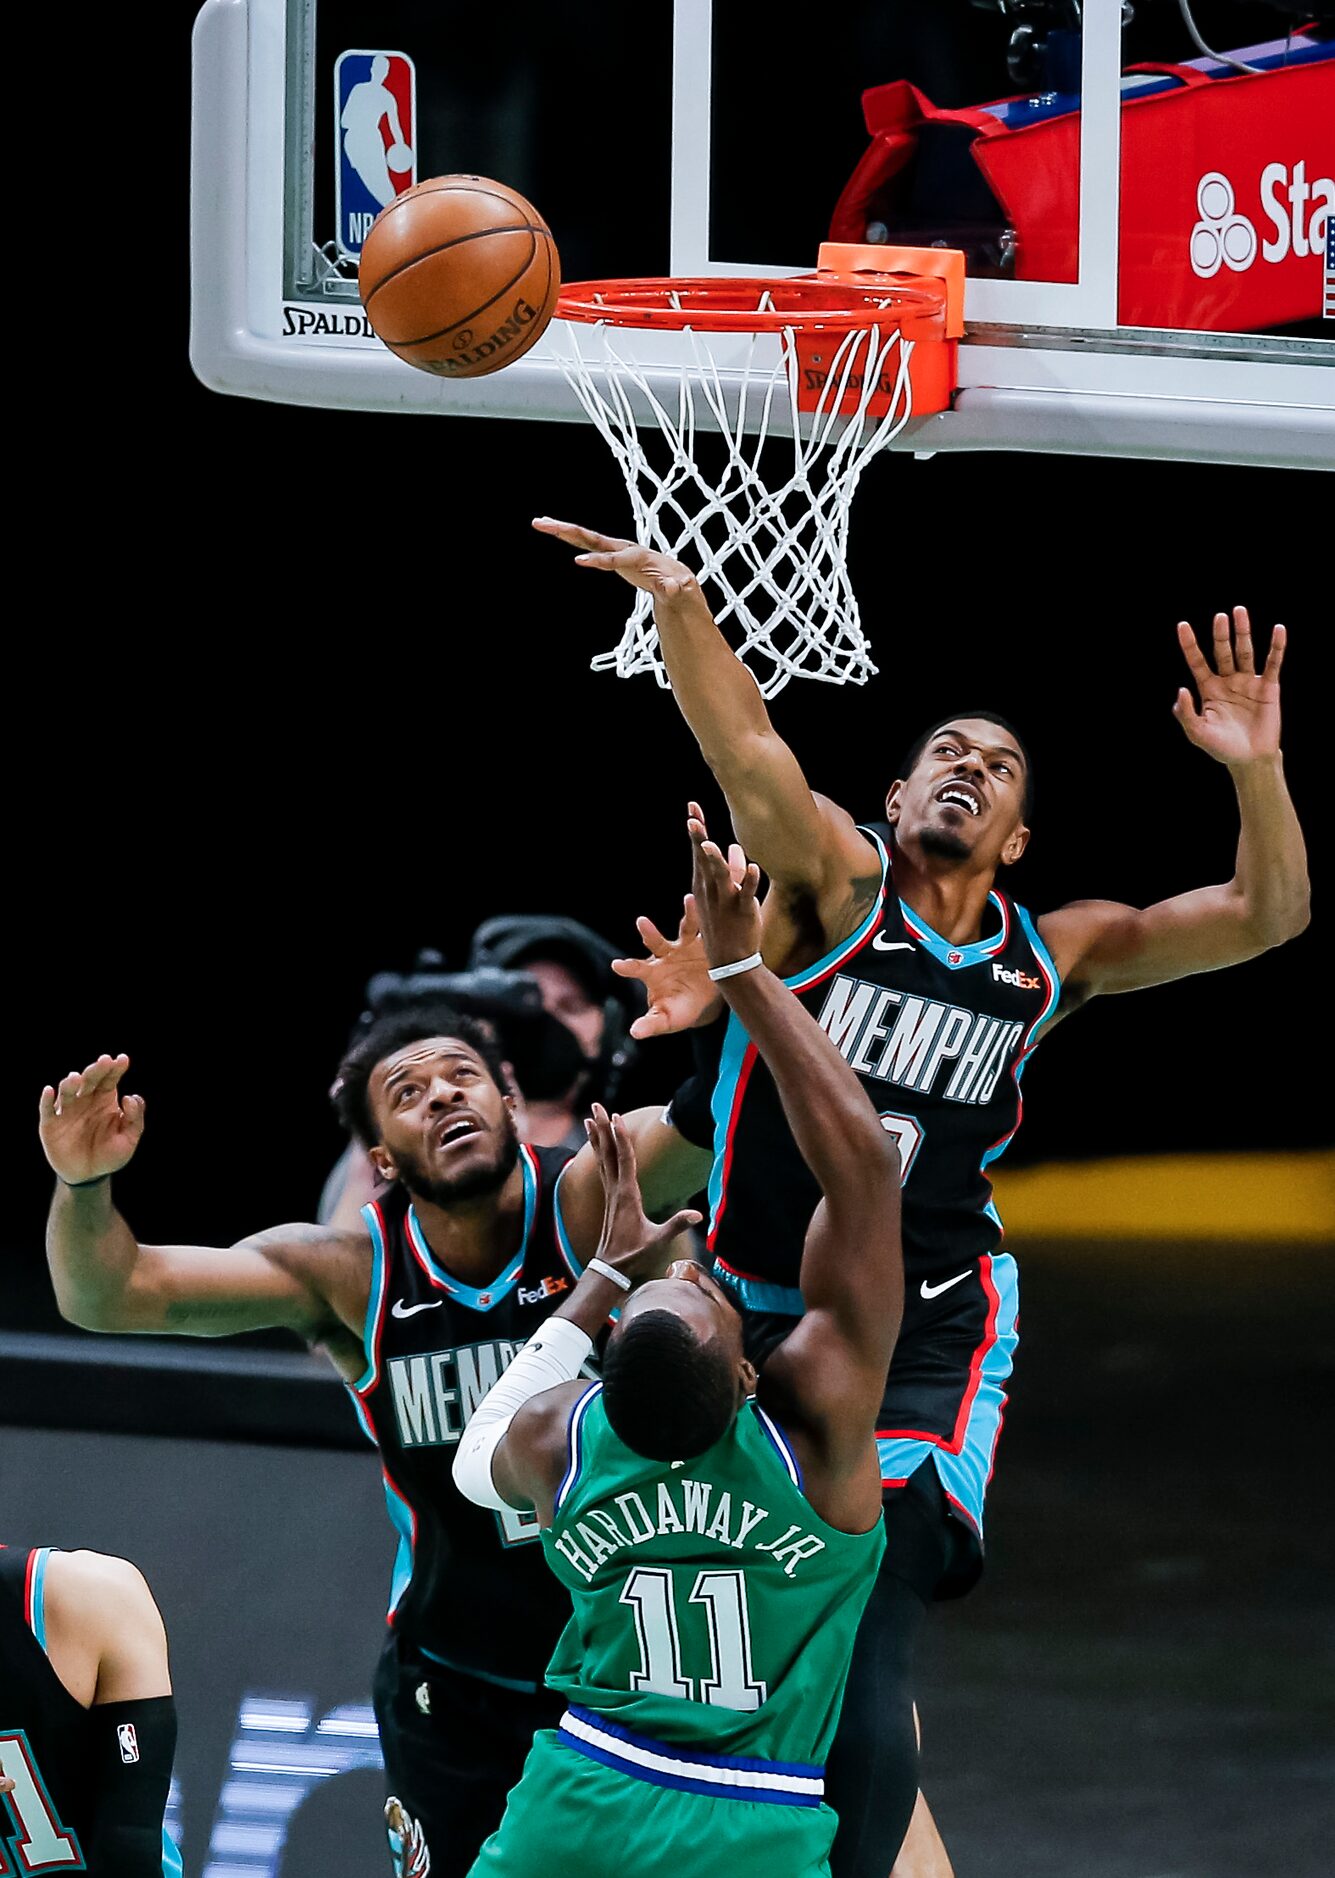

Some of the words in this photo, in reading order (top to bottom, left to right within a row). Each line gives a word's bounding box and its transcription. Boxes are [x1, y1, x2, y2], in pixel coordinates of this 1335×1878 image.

[992, 963, 1041, 989] FedEx
[818, 973, 1025, 1106] MEMPHIS
[517, 1276, 569, 1305] FedEx
[554, 1479, 769, 1583] HARDAWAY
[619, 1566, 767, 1712] 11
